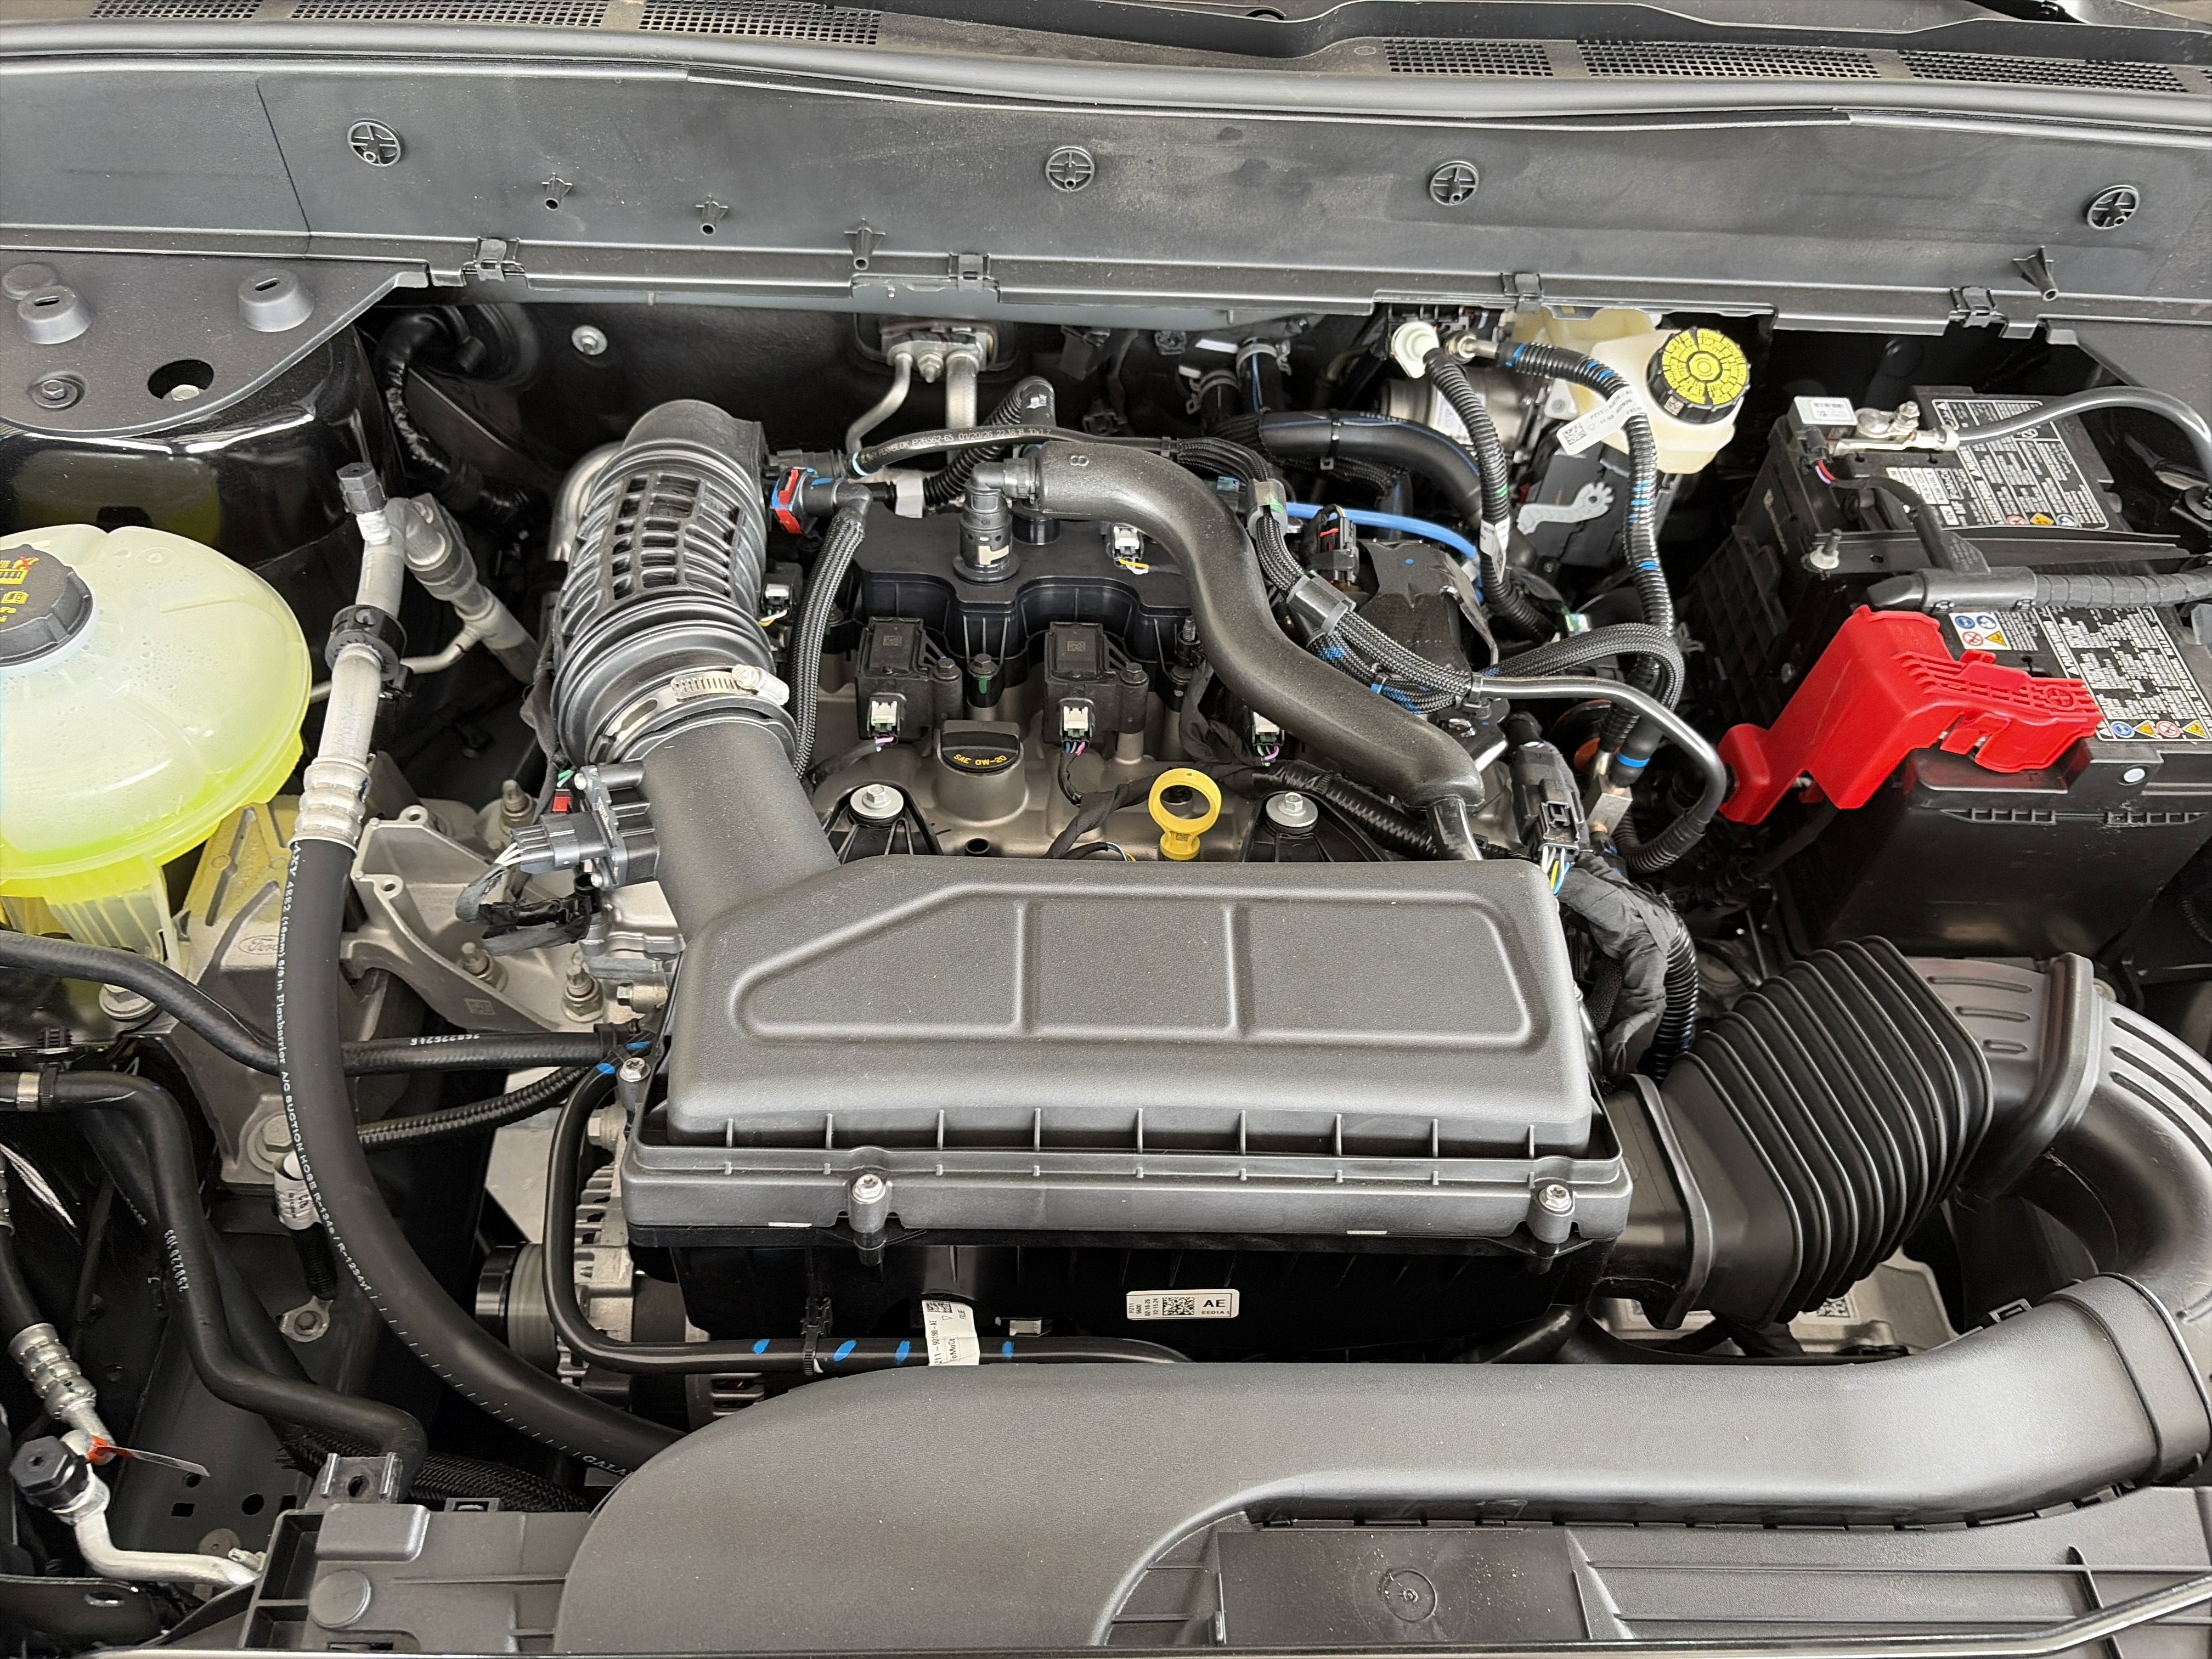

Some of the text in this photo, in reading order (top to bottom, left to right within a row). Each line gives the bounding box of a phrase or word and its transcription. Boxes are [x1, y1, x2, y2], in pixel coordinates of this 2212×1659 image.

[958, 431, 993, 441] 01/20/26
[1940, 470, 1962, 499] FoMoCo
[2042, 620, 2075, 667] PELIGRO VENENO
[953, 754, 1008, 766] SAE 0W-20
[290, 842, 301, 877] AXY
[283, 882, 295, 912] 4882
[276, 994, 287, 1064] Flexbarrier
[281, 1071, 291, 1091] A/C
[285, 1095, 304, 1152] SUCTION
[300, 1154, 318, 1190] HOSE
[313, 1192, 335, 1234] R-134a
[1203, 1299, 1226, 1307] AE
[582, 1455, 632, 1476] GALA
